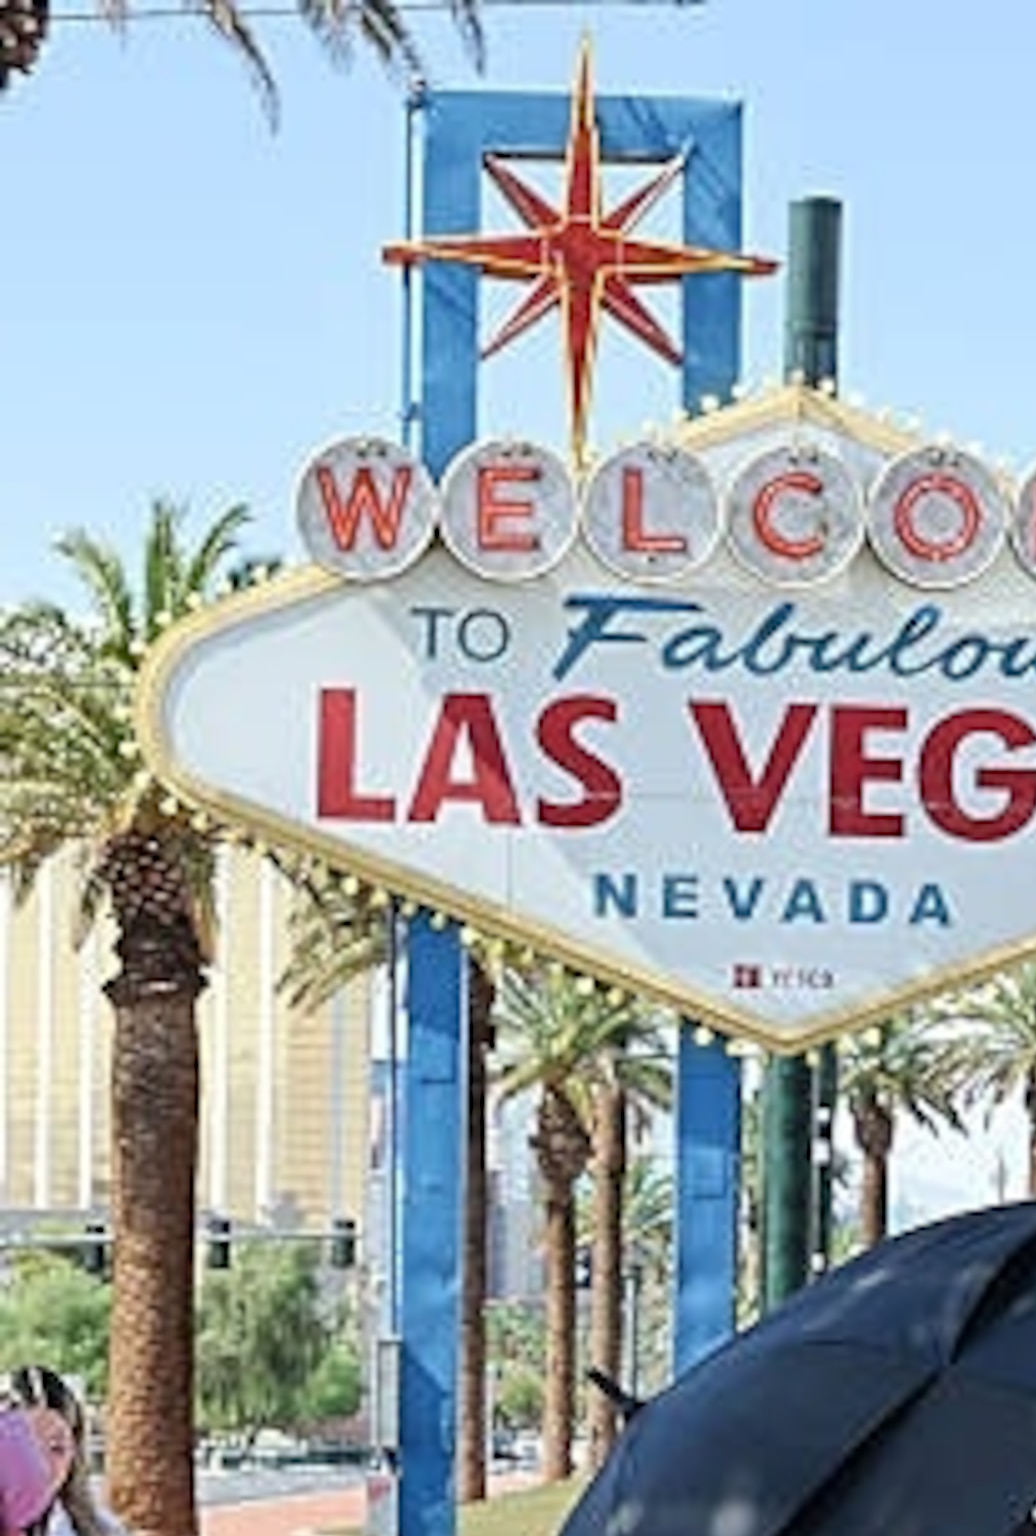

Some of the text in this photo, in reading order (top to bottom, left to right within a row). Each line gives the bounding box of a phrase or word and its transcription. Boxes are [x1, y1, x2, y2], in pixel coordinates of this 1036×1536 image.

[410, 606, 511, 663] TO
[317, 688, 624, 827] LAS
[595, 874, 952, 927] NEVADA
